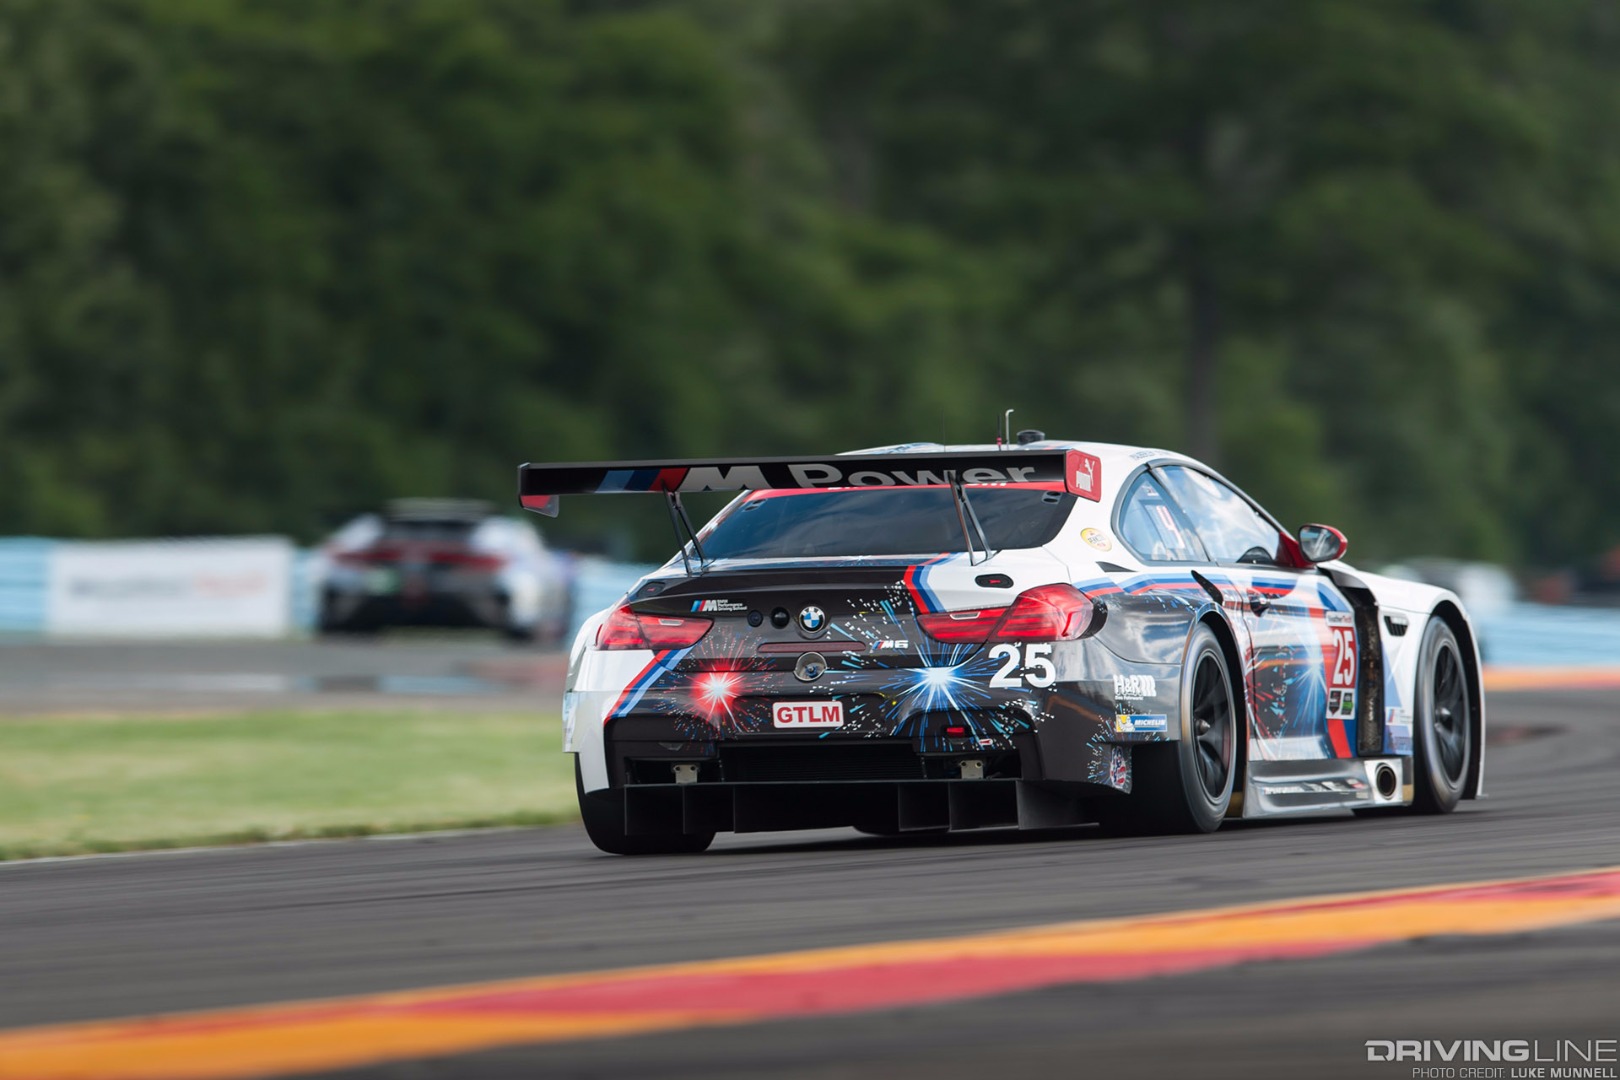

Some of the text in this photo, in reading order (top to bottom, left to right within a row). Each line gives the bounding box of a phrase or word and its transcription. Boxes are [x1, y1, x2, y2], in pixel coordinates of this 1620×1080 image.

[676, 463, 1035, 491] M Power
[881, 639, 909, 649] M6
[988, 643, 1057, 689] 25
[1332, 628, 1356, 686] 25
[1113, 674, 1157, 697] H&R
[776, 705, 841, 724] GTLM
